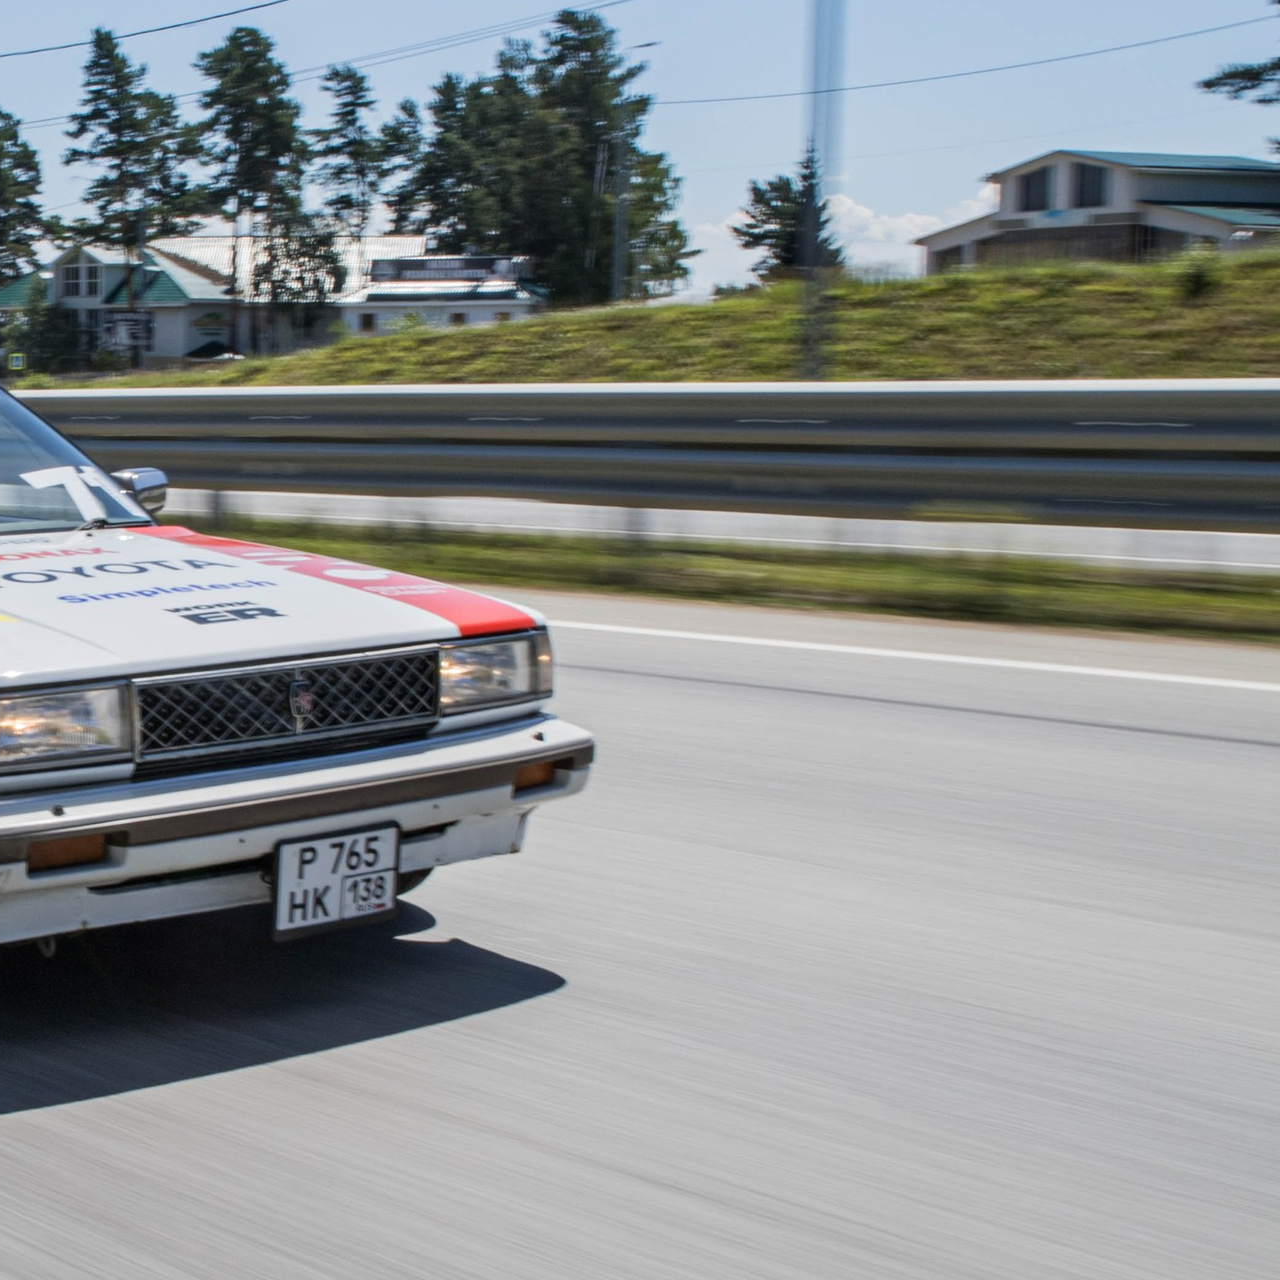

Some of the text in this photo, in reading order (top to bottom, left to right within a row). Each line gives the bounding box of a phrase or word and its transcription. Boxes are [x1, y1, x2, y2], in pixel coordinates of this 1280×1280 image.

[57, 577, 280, 604] Simpletech
[162, 600, 258, 613] WORK
[179, 607, 290, 625] ER
[329, 836, 379, 874] 765
[347, 876, 385, 903] 138
